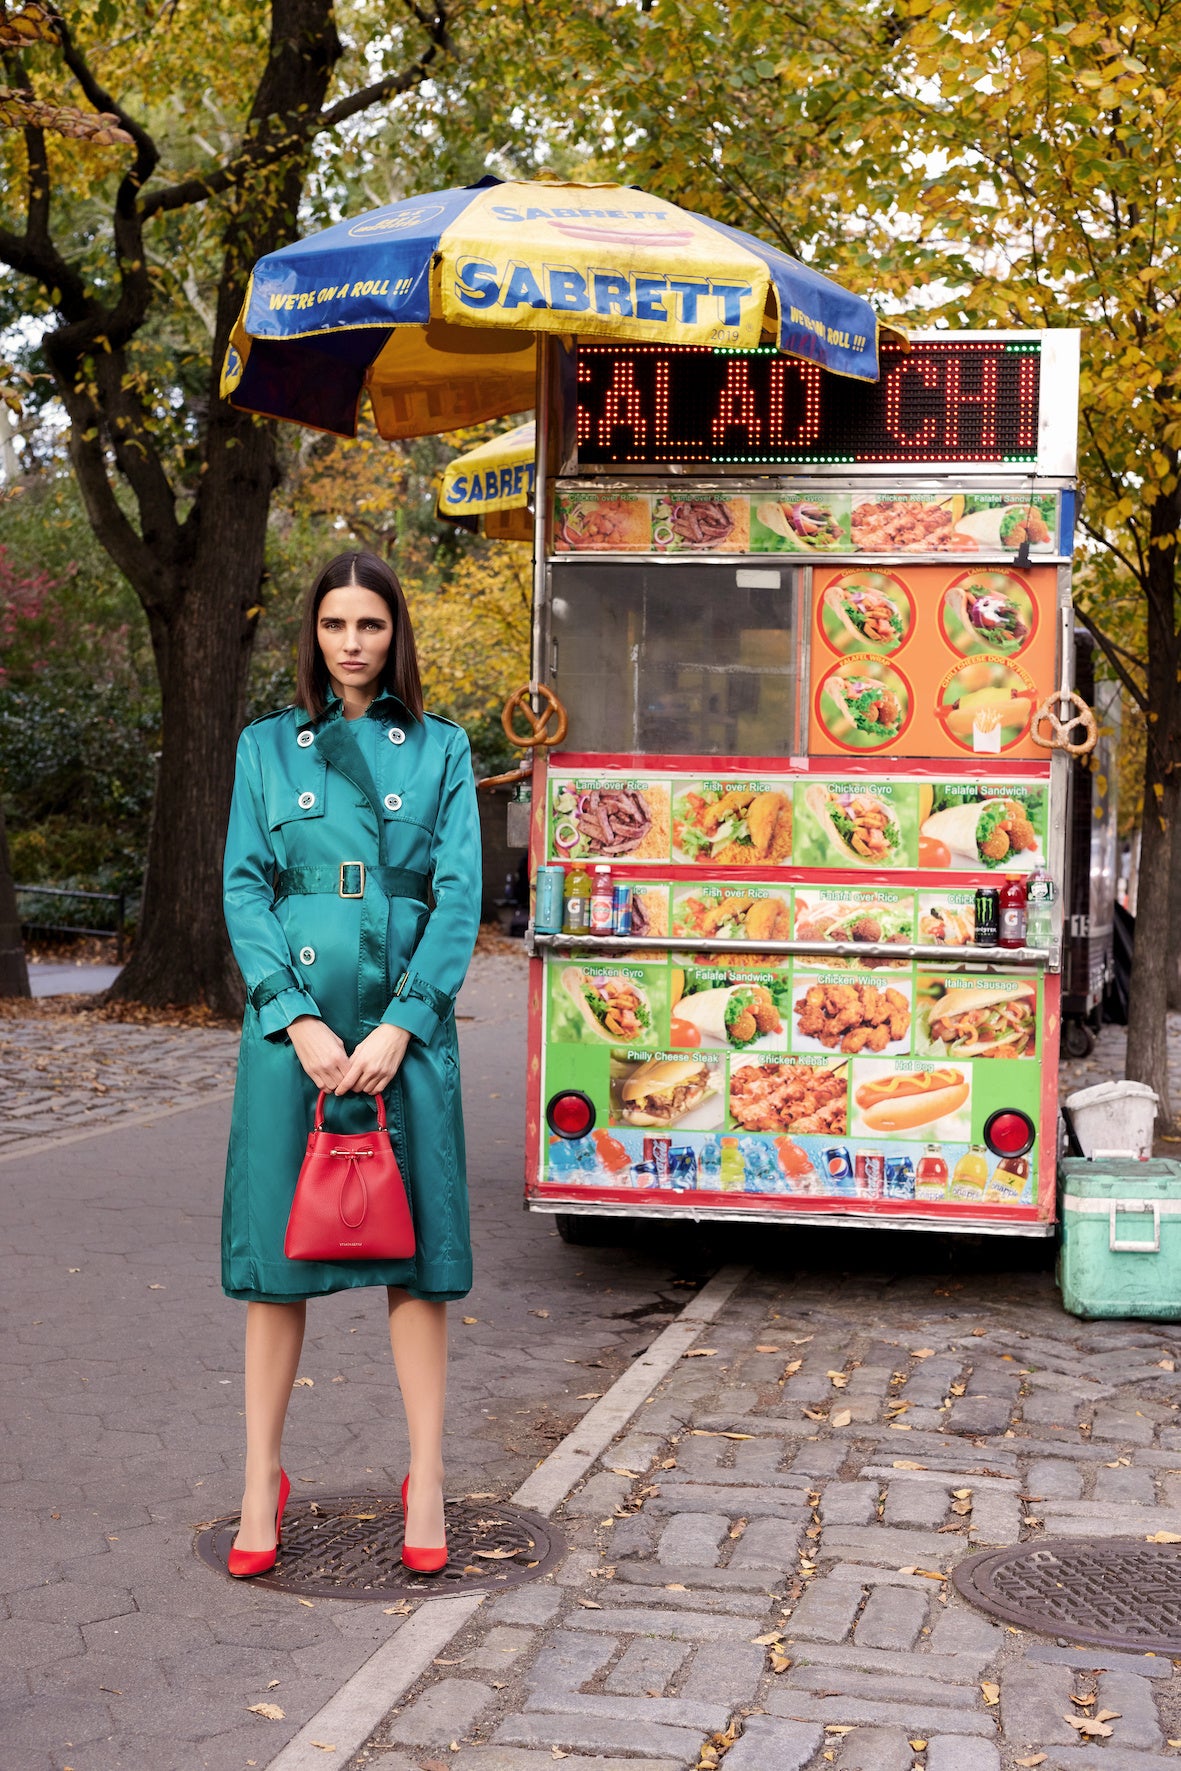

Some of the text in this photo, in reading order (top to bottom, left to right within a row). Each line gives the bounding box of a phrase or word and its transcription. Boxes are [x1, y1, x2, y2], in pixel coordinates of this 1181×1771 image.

[491, 205, 671, 223] SABRETT
[269, 290, 316, 311] WE'RE
[317, 286, 339, 304] ON
[336, 283, 350, 299] A
[350, 279, 390, 298] ROLL
[455, 255, 752, 326] SABRETT
[711, 328, 739, 342] 2019
[827, 327, 850, 349] ROLL
[886, 358, 1034, 447] CHI
[974, 494, 1043, 503] Falafel Sandwch
[988, 655, 1005, 664] DOG
[575, 780, 649, 791] Lamb over Rice
[703, 782, 771, 793] Fish over Rice
[827, 784, 893, 796] Chicken Gyro
[945, 785, 1028, 797] Falafel Sandwich
[632, 887, 648, 896] ice
[702, 887, 769, 899] Fish over Rice
[819, 890, 899, 903] Falafel over Rice
[567, 898, 580, 914] G
[1004, 910, 1018, 926] G
[582, 966, 644, 979] Chicken Gyro
[695, 970, 774, 982] Falafel Sandwich
[817, 975, 887, 988] Chicken Wings
[945, 979, 1018, 991] Italian Sausage
[627, 1050, 719, 1063] Philly Cheese Steak
[758, 1055, 829, 1066] Chicken Kebab
[895, 1060, 935, 1073] Hot Dog
